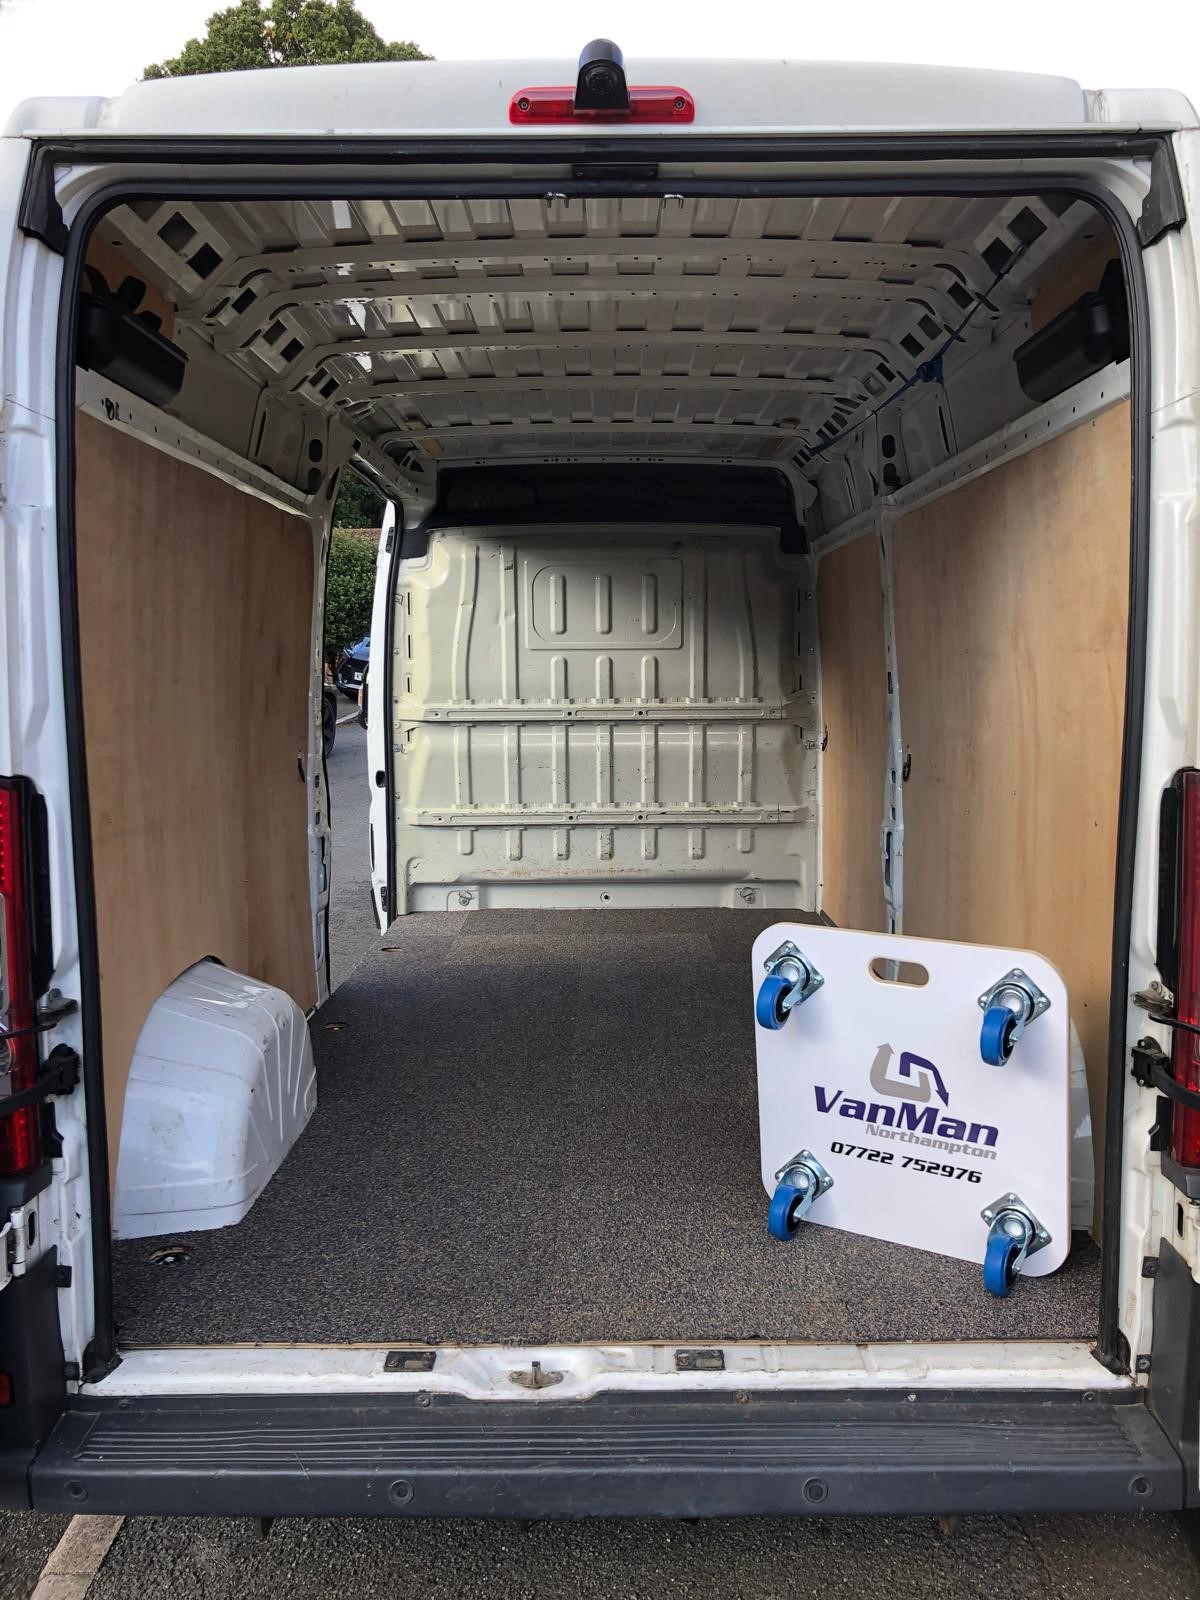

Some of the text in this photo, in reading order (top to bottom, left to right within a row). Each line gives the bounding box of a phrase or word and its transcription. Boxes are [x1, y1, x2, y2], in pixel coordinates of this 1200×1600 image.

[814, 1086, 999, 1147] VanMan
[830, 1141, 983, 1183] 07722 752976
[865, 1123, 997, 1160] Northampton
